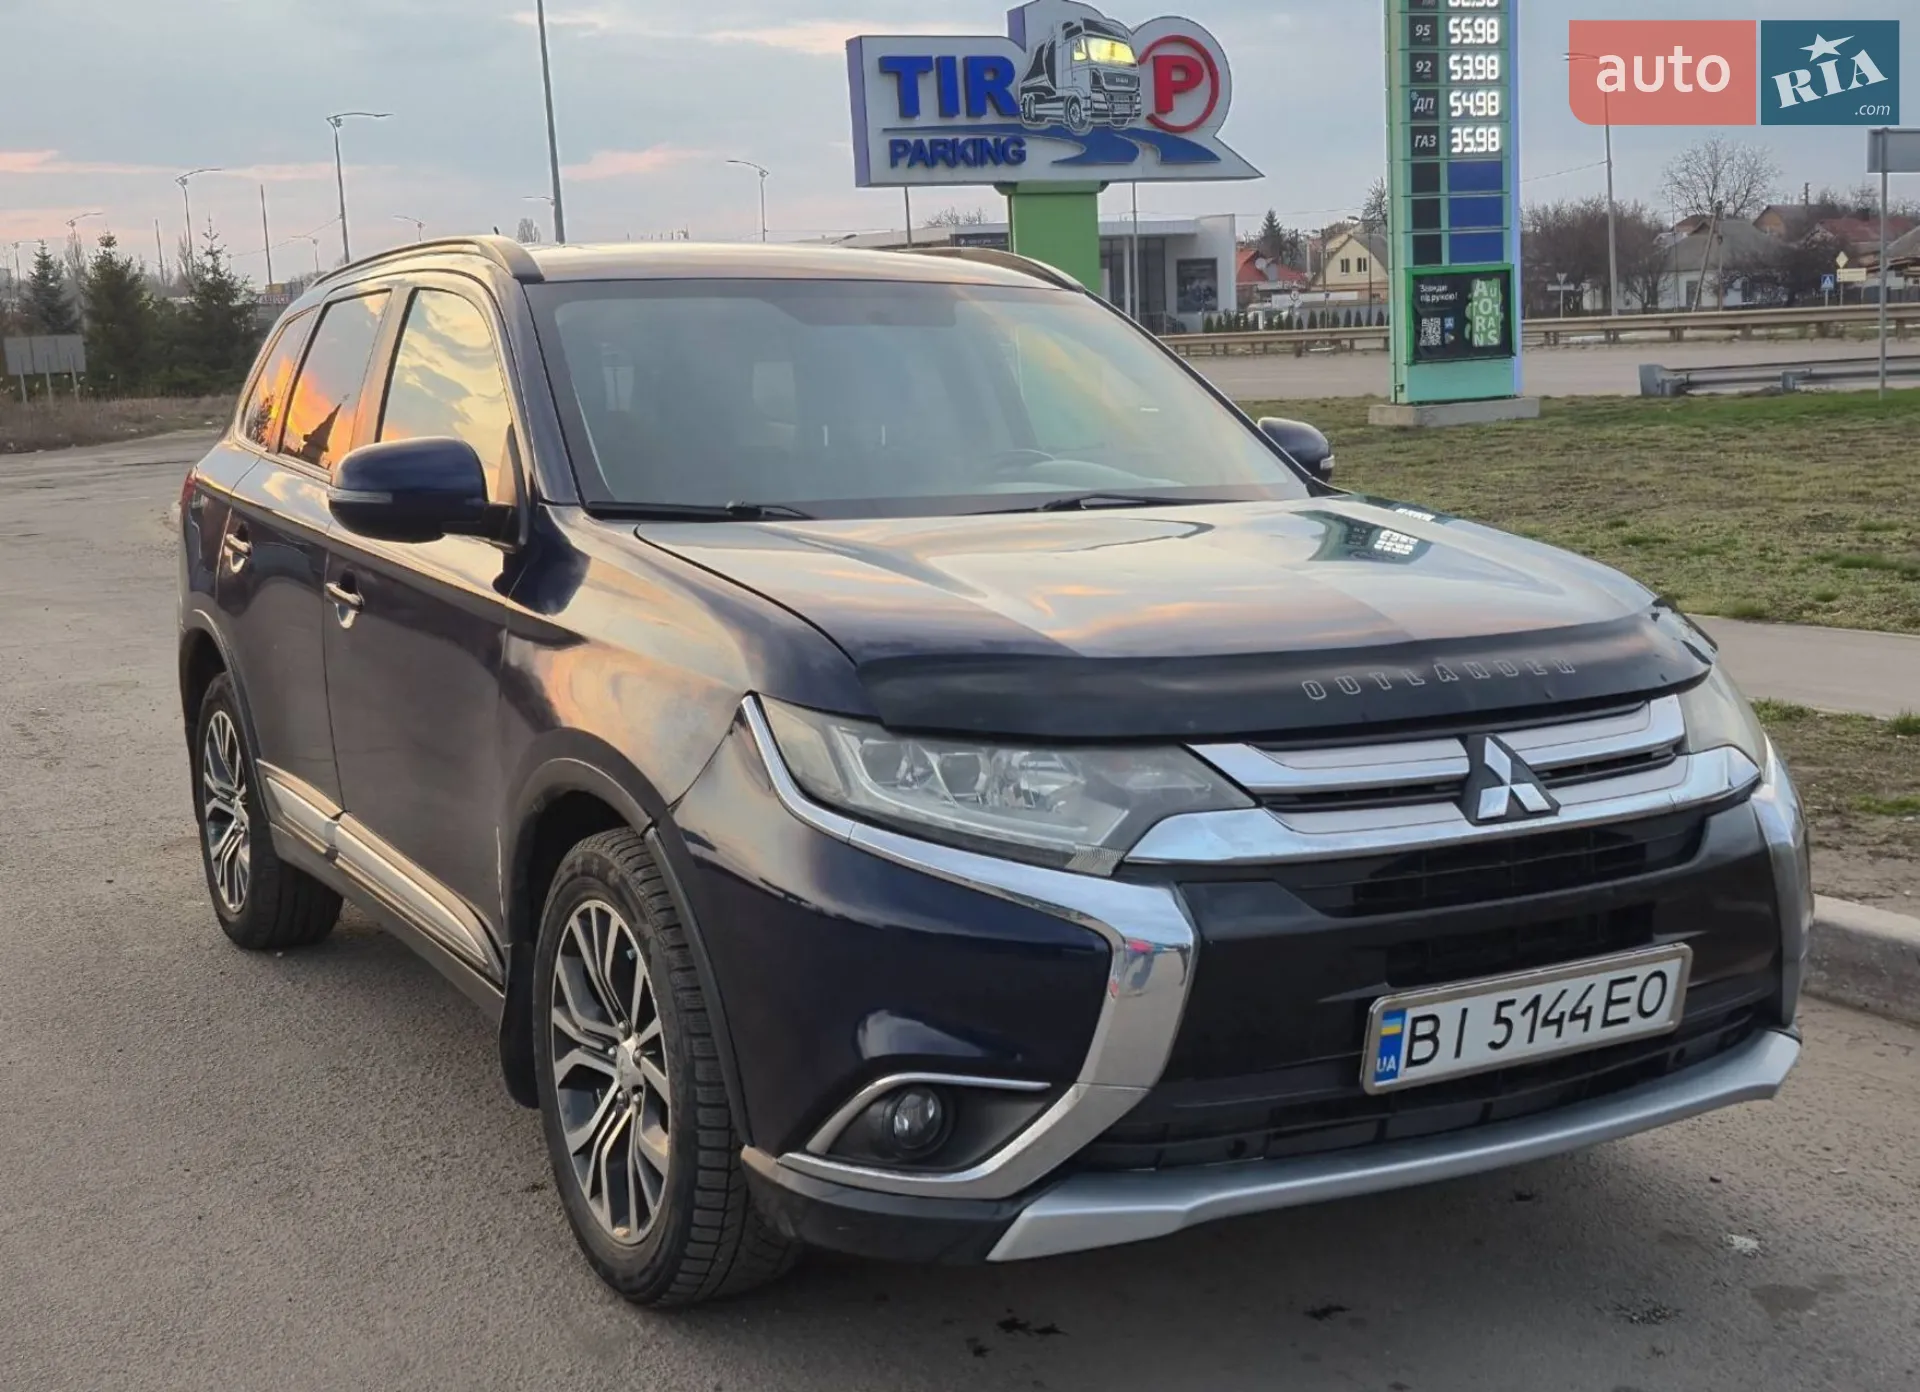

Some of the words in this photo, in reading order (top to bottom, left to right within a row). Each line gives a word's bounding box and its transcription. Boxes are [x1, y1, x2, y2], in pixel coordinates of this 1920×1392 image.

[1415, 24, 1431, 36] 95
[1449, 17, 1499, 44] 55.98
[1415, 61, 1432, 73] 92
[1449, 54, 1499, 80] 53.98
[878, 55, 1019, 118] TIR
[1152, 54, 1204, 114] P
[1414, 98, 1434, 112] ДП
[889, 137, 1026, 168] PARKING
[1414, 135, 1436, 148] ГАЗ
[1451, 126, 1500, 153] 35.98
[1405, 1007, 1468, 1069] BI
[1376, 1054, 1397, 1073] UA
